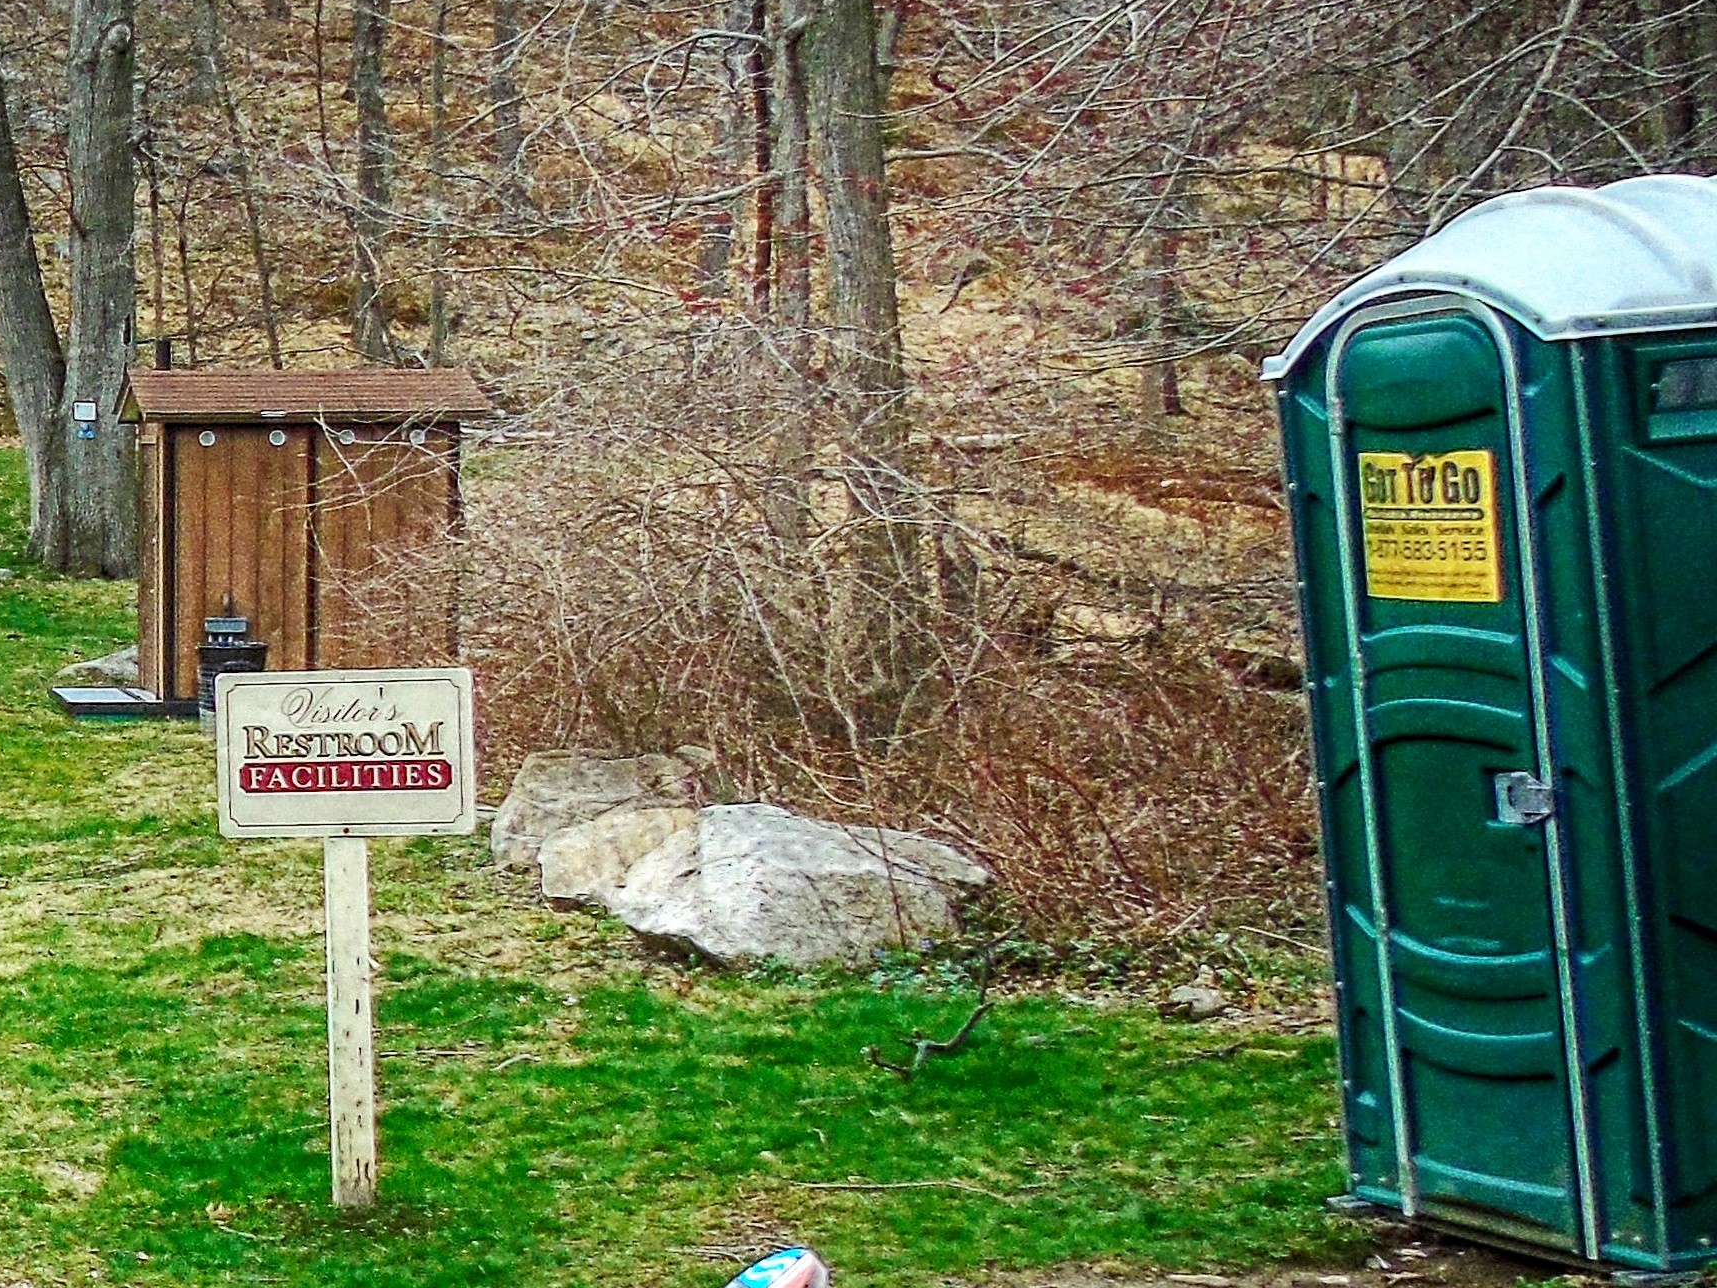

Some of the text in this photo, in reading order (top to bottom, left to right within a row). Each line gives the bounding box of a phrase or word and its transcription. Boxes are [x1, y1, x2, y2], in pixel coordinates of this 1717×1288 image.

[281, 685, 403, 728] Visitor's
[242, 720, 445, 759] RESTROOM
[248, 765, 443, 790] FACILITIES
